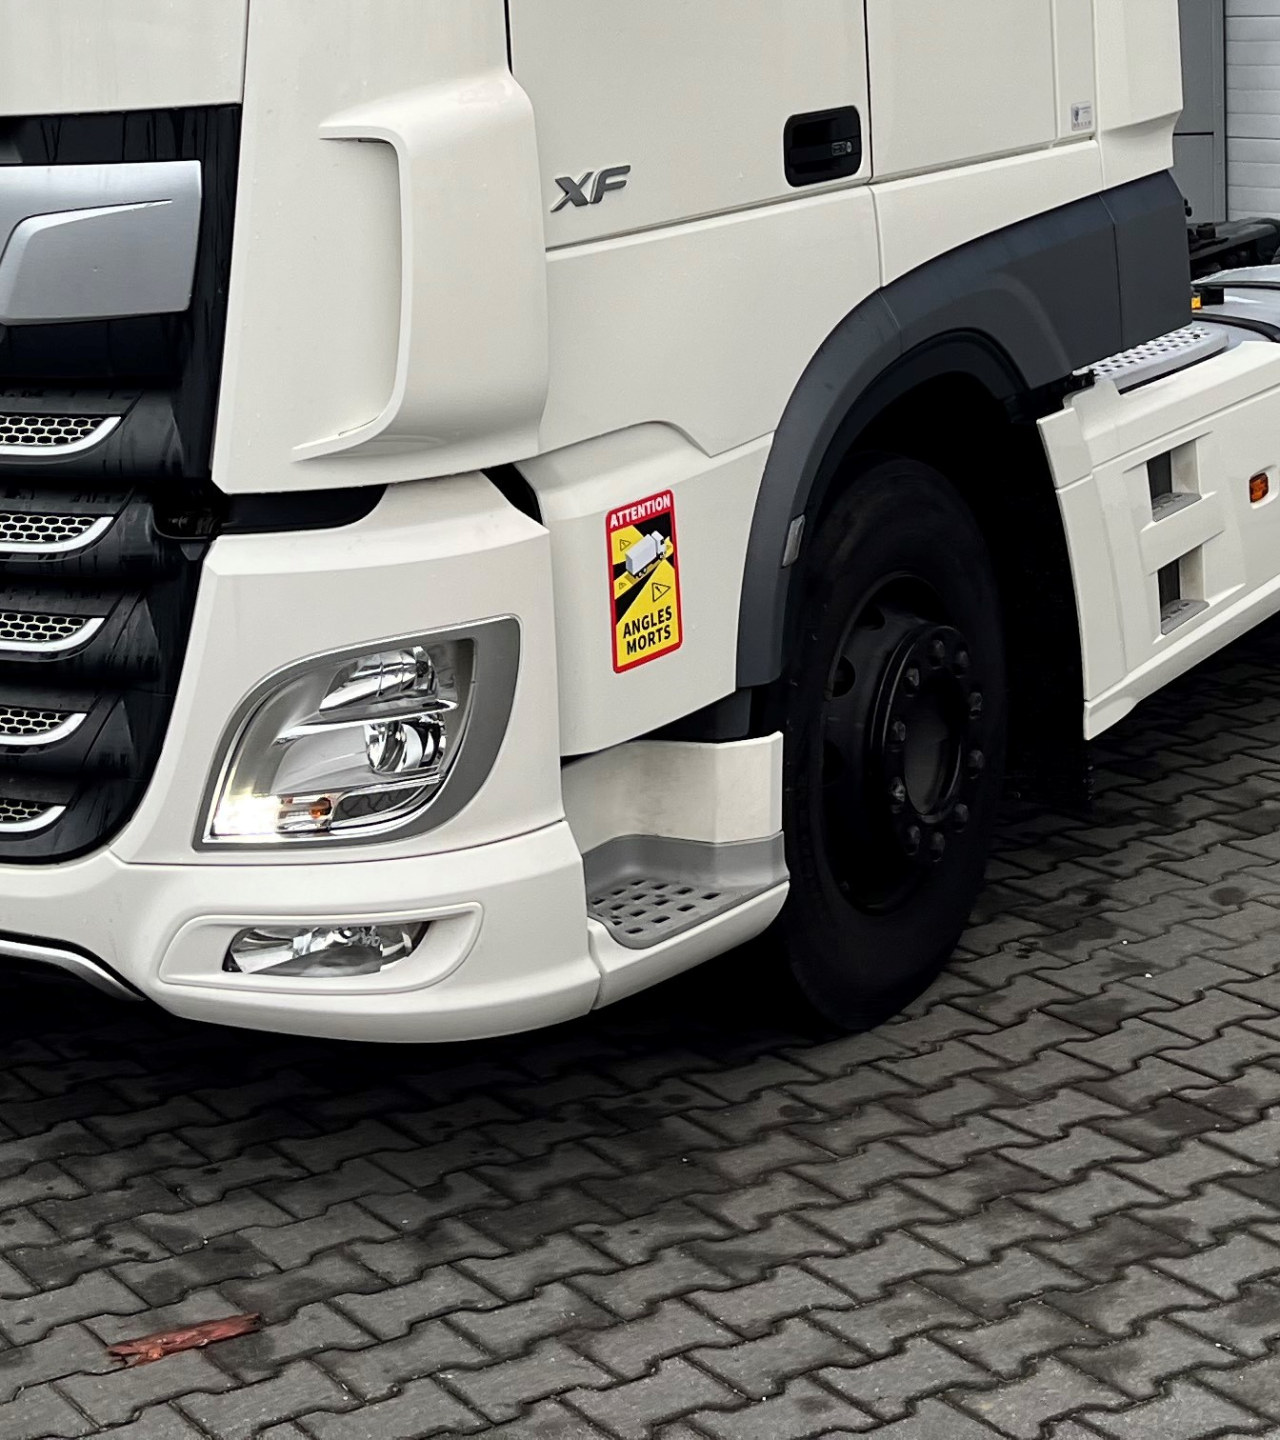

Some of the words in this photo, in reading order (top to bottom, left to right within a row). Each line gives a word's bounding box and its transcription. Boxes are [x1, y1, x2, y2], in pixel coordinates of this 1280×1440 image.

[550, 165, 631, 213] XF
[609, 493, 671, 529] ATTENTION
[623, 605, 672, 639] ANGLES
[626, 624, 671, 656] MORTS
